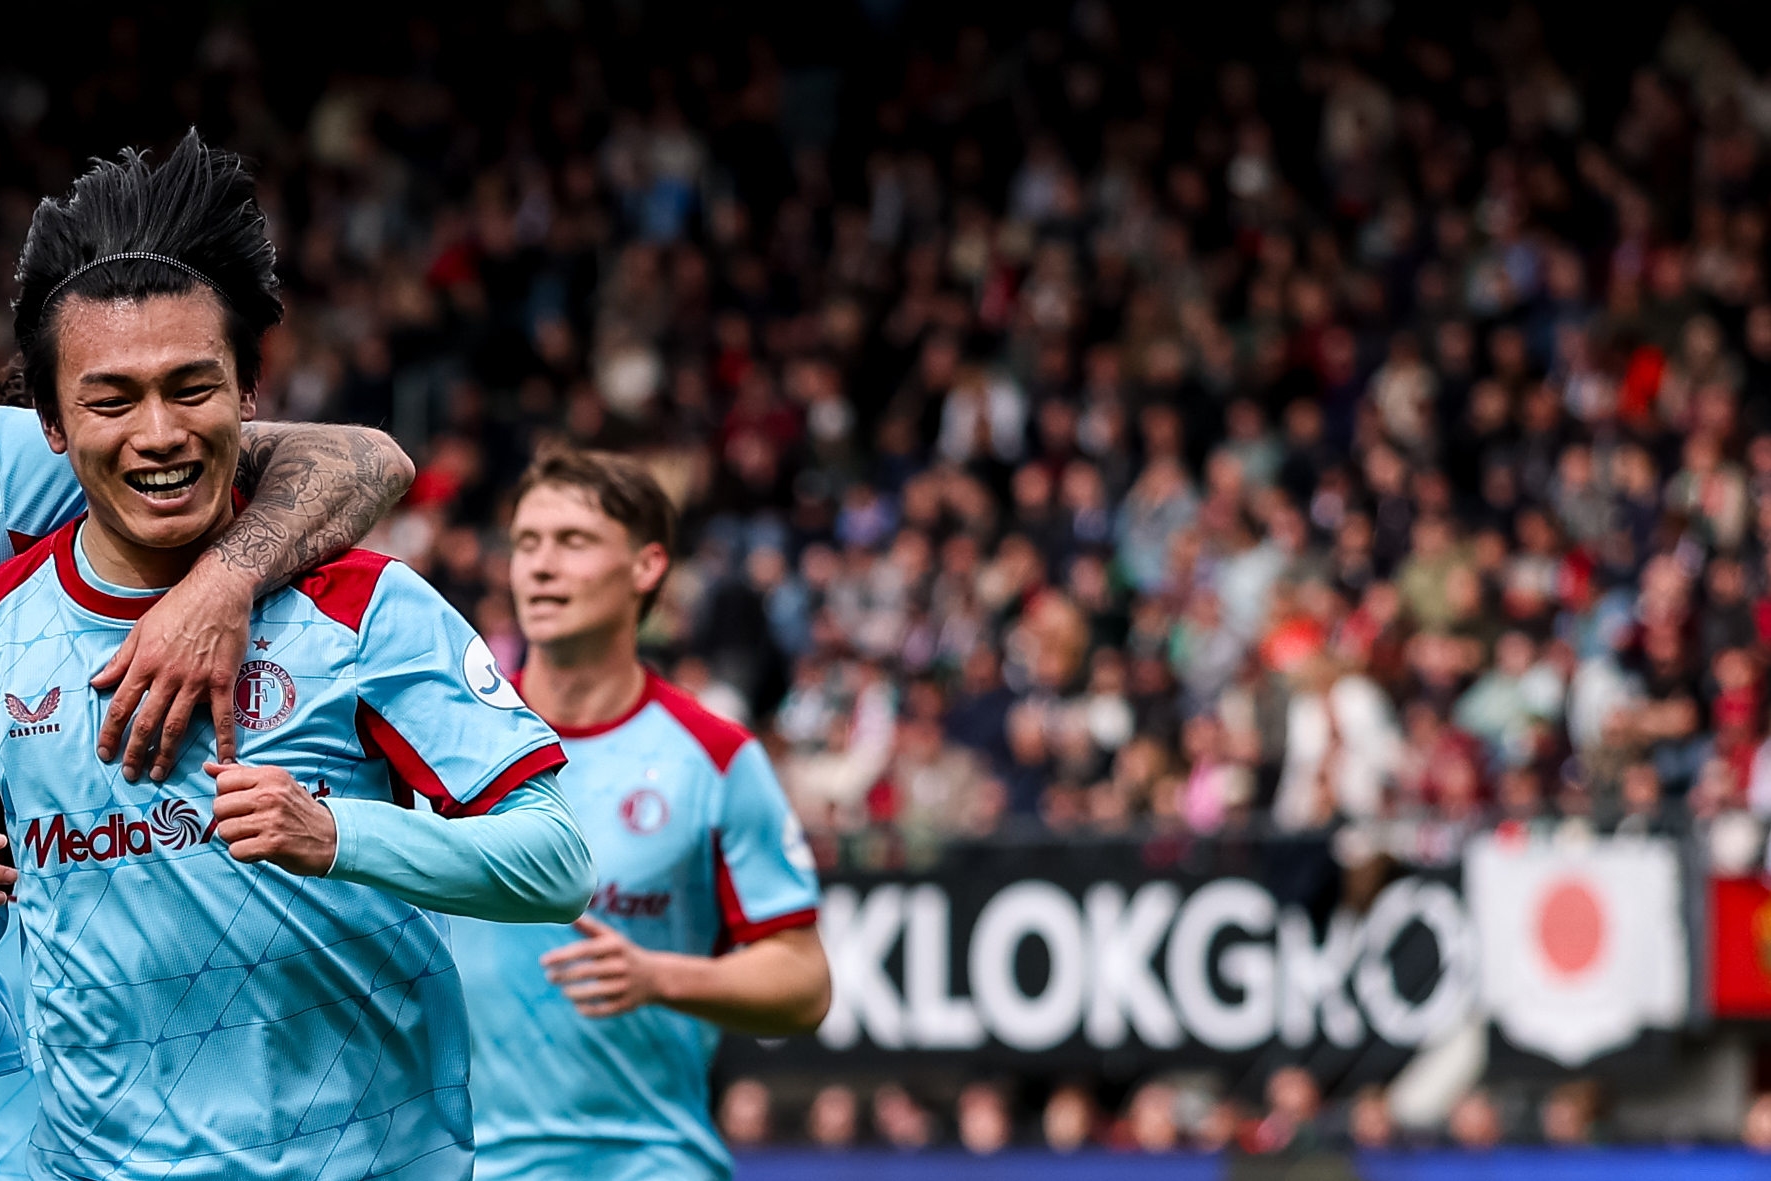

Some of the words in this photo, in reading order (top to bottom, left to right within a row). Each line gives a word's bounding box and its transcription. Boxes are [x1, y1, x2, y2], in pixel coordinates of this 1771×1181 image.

[246, 677, 275, 712] F
[9, 723, 60, 738] CASTORE
[25, 813, 153, 868] Media
